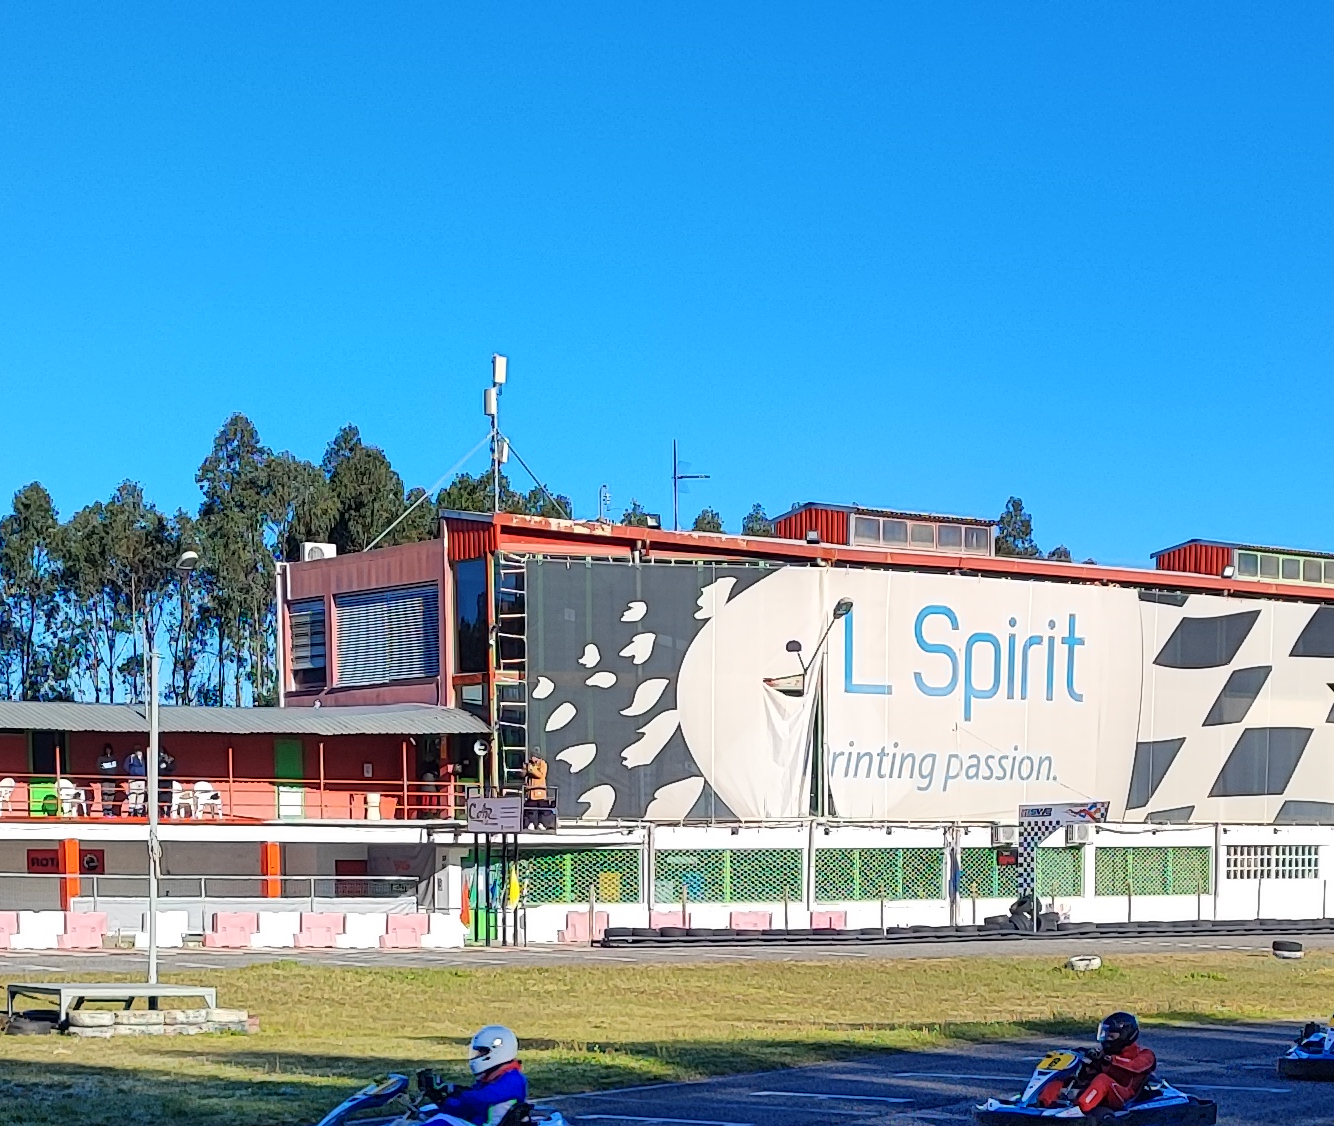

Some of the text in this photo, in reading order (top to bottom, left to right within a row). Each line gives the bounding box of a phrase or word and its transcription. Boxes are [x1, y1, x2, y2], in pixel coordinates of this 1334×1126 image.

[844, 603, 1086, 722] L Spirit
[823, 741, 1058, 792] rinting passion.
